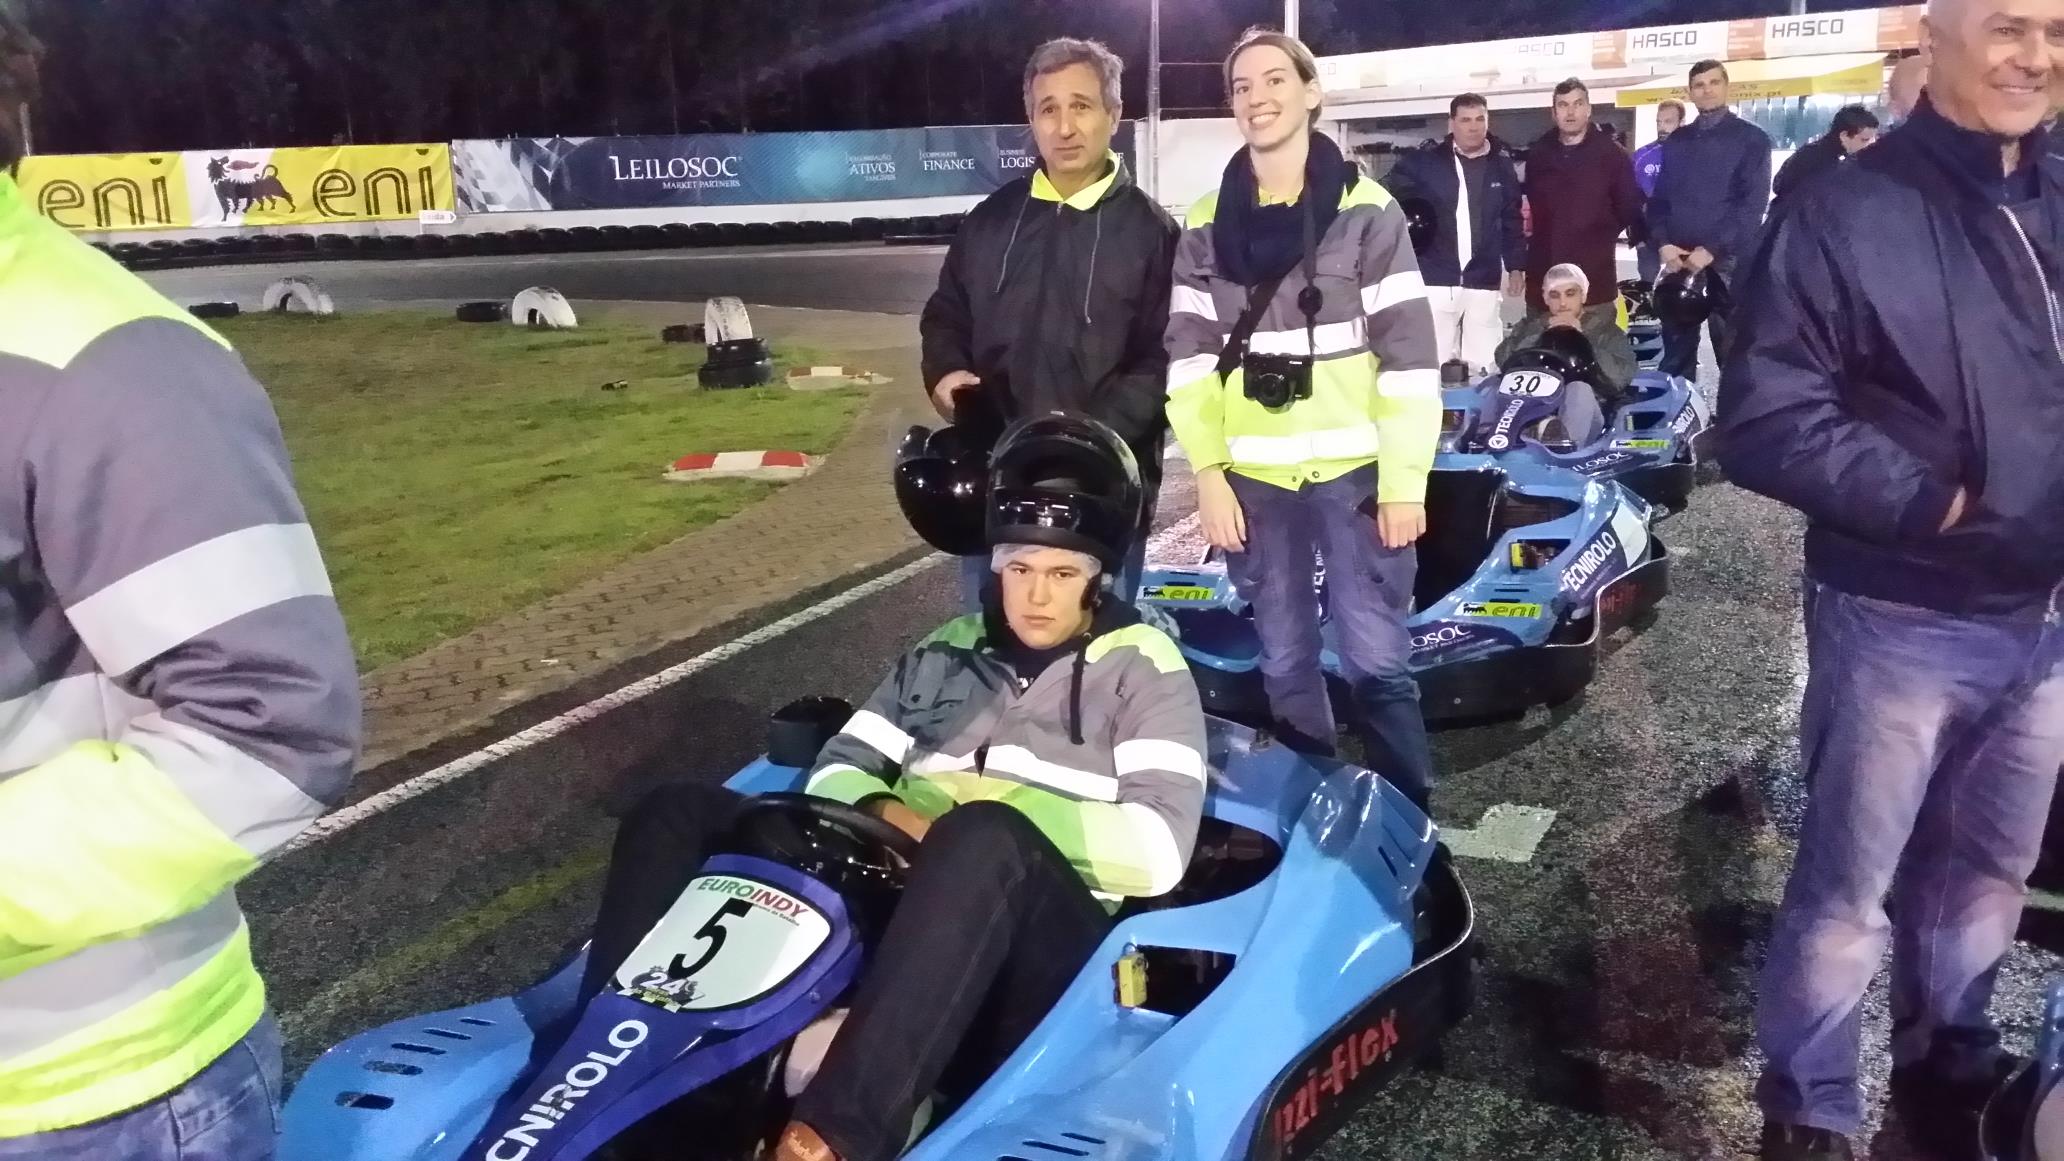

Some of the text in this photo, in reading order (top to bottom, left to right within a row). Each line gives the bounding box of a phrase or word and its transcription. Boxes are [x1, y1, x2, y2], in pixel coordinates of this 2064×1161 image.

[1772, 18, 1844, 39] HASCO
[1633, 30, 1698, 49] HASCO
[609, 155, 739, 180] LEILOSOC
[849, 161, 896, 175] ATIVOS
[924, 158, 976, 171] FINANCE
[37, 157, 173, 228] eni
[313, 148, 436, 217] eni
[663, 181, 697, 190] MARKET
[1509, 374, 1542, 393] 30
[1560, 531, 1617, 592] TECNIROLO
[1169, 587, 1210, 600] eni
[1491, 603, 1537, 617] eni
[697, 878, 809, 918] EUROINDY
[666, 896, 754, 981] 5
[640, 971, 688, 996] 24
